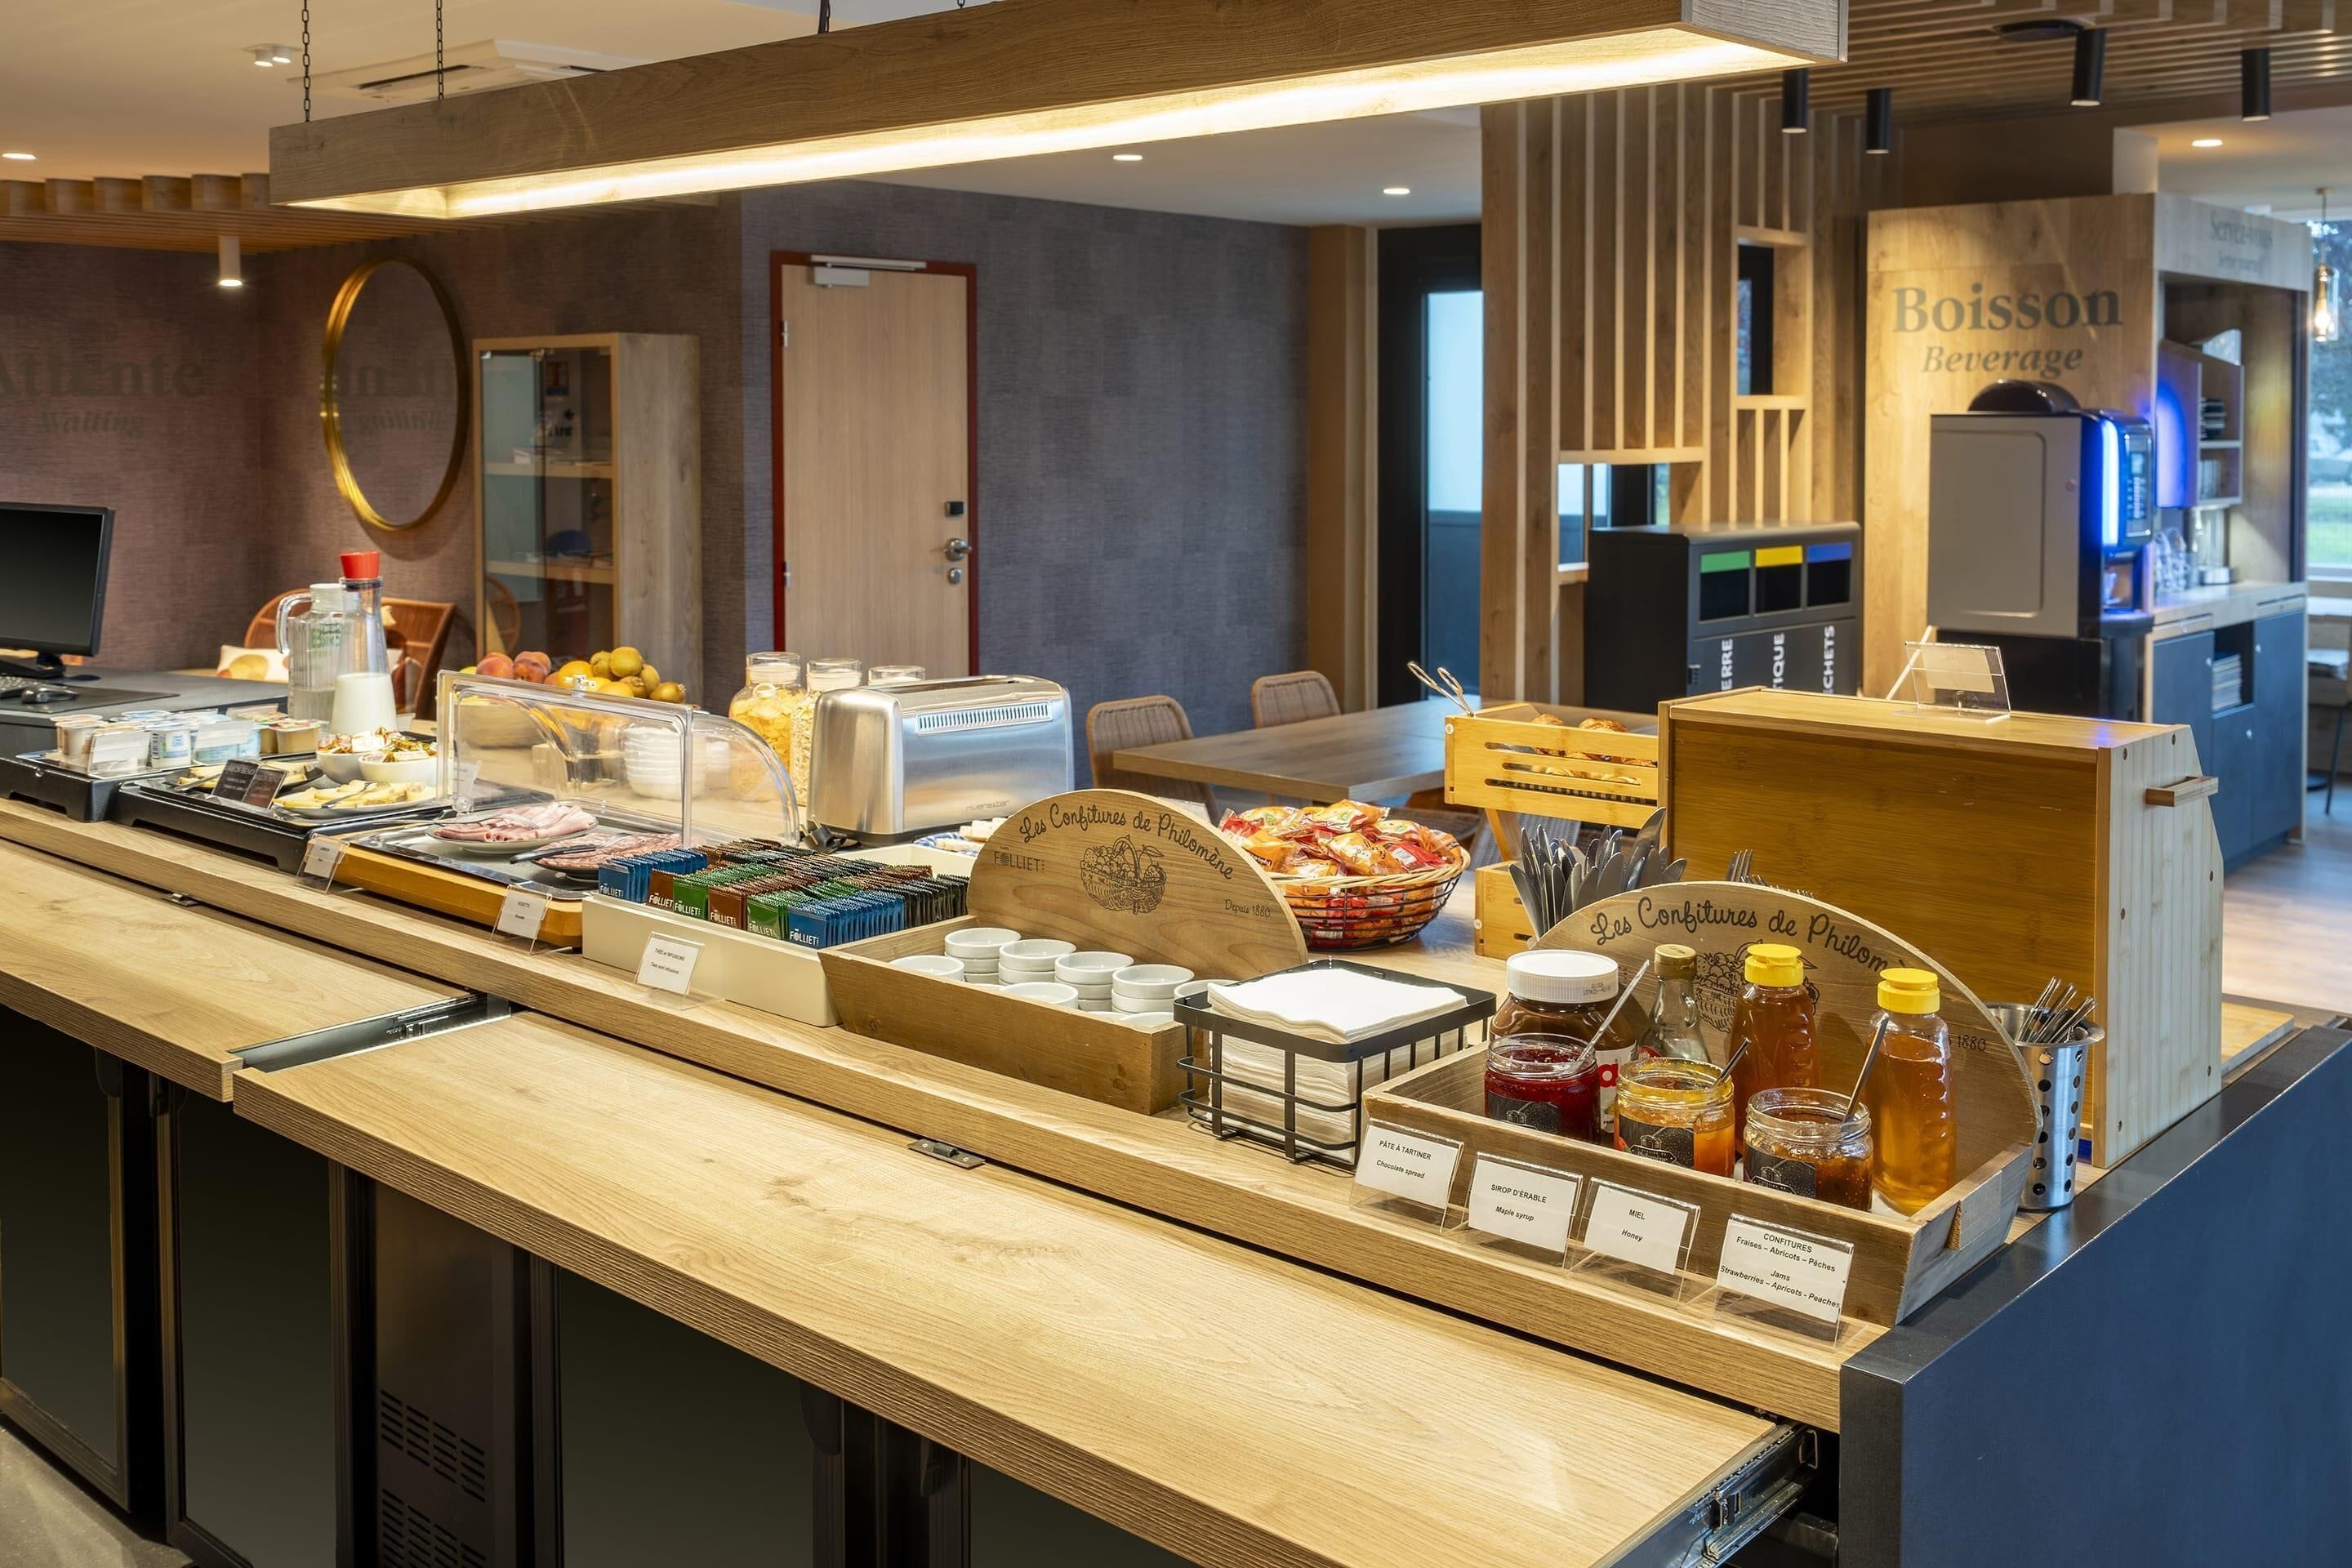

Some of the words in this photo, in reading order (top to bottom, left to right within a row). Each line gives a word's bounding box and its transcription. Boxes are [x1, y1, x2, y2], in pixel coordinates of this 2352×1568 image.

[1891, 283, 2123, 333] Boisson
[1921, 345, 2084, 380] Beverage
[1019, 817, 1046, 843] Les
[1049, 803, 1126, 831] Confitures
[1133, 811, 1152, 831] de
[1158, 813, 1234, 880] Philomène
[994, 850, 1041, 872] FOLLIET
[1225, 899, 1249, 914] Depuis
[1252, 906, 1272, 918] 1880
[790, 931, 817, 946] FOLLIET
[1590, 912, 1632, 946] Les
[1638, 897, 1758, 933] Confitures
[1768, 910, 1797, 936] de
[1807, 914, 1905, 972] Philom
[1958, 1034, 1987, 1051] 1880
[1379, 1140, 1395, 1151] PÂTE
[1402, 1147, 1432, 1160] TARTINER
[1376, 1160, 1404, 1173] Chocolate
[1405, 1169, 1425, 1179] spread
[1490, 1184, 1512, 1195] SIROP
[1495, 1205, 1515, 1217] Maple
[1515, 1213, 1535, 1223] syrup
[1628, 1209, 1646, 1221] MIEL
[1621, 1228, 1643, 1242] Honey
[1763, 1232, 1812, 1254] CONFITURES
[1736, 1236, 1762, 1250] Fraises
[1769, 1246, 1801, 1263] Abricots
[1808, 1257, 1836, 1272] Pêches
[1771, 1270, 1790, 1282] Jams
[1720, 1265, 1764, 1285] Strawberries
[1771, 1281, 1802, 1297] Apricots
[1808, 1292, 1841, 1309] Peaches
